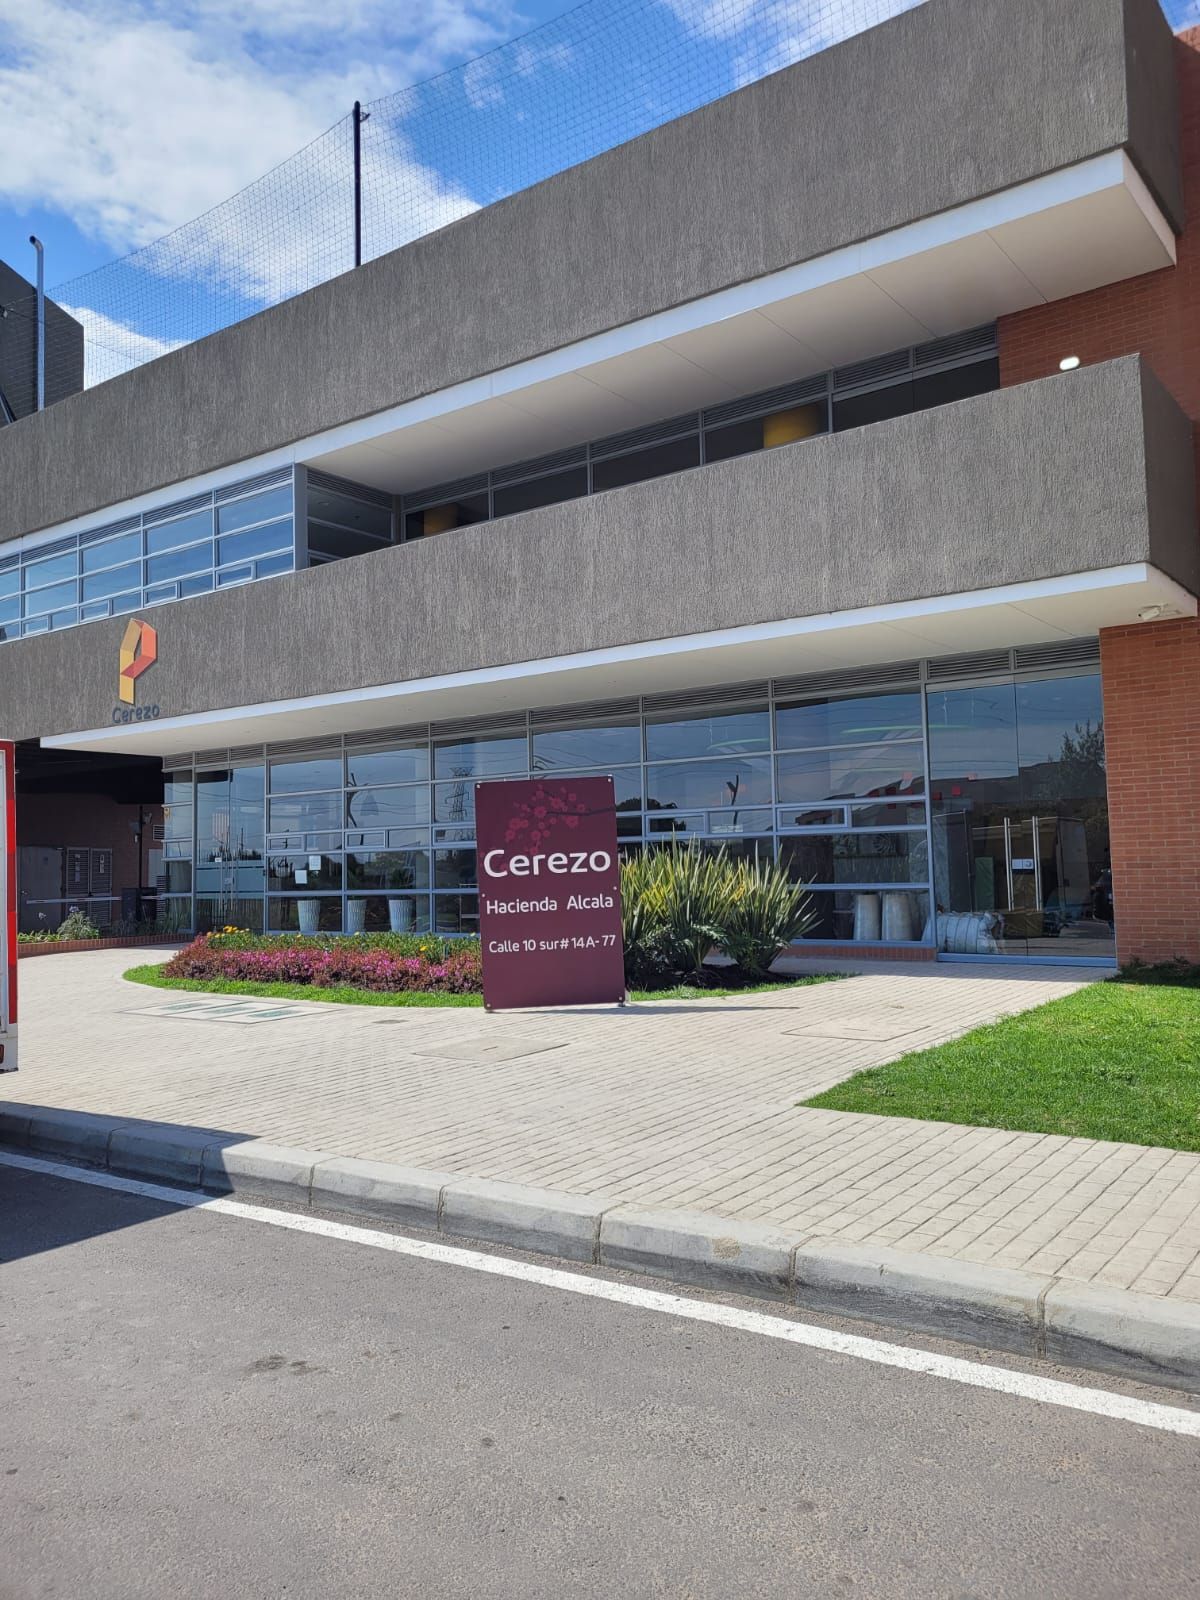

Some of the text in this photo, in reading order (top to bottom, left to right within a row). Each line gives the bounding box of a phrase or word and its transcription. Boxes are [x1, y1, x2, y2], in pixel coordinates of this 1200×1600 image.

[112, 704, 160, 724] Cerezo
[483, 849, 611, 878] Cerezo
[486, 893, 614, 915] Hacienda Alcala
[488, 939, 520, 953] Calle
[522, 939, 537, 952] 10
